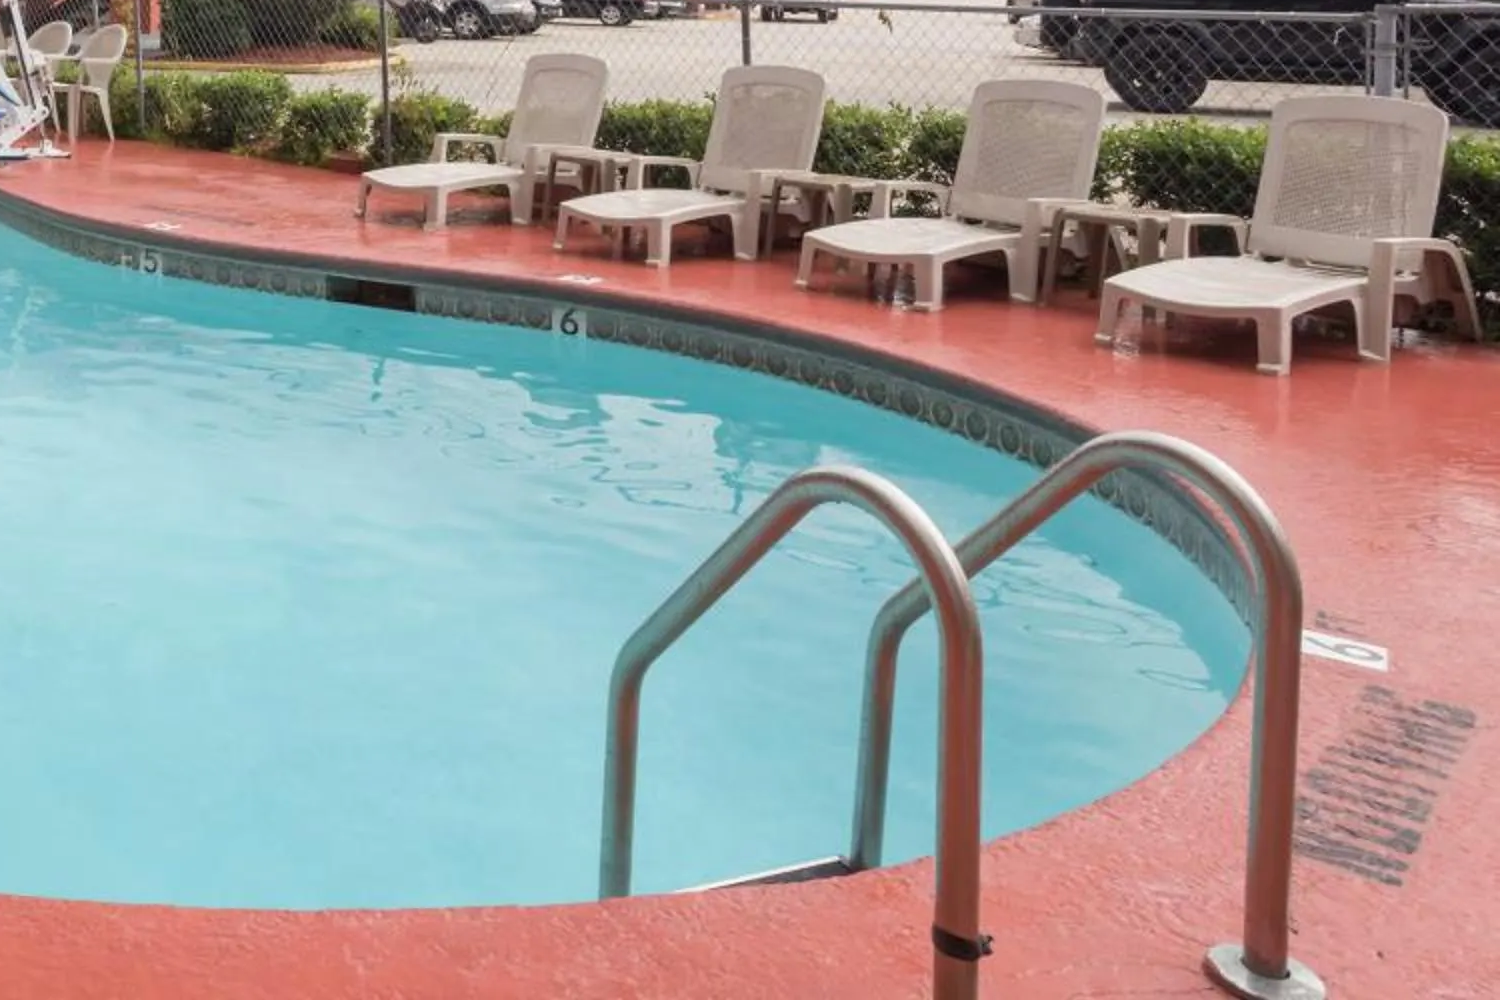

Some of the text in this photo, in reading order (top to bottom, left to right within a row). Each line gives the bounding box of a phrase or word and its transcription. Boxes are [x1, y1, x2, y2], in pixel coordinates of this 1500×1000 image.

[144, 247, 158, 273] 5
[560, 307, 579, 335] 6
[1302, 636, 1384, 662] 6
